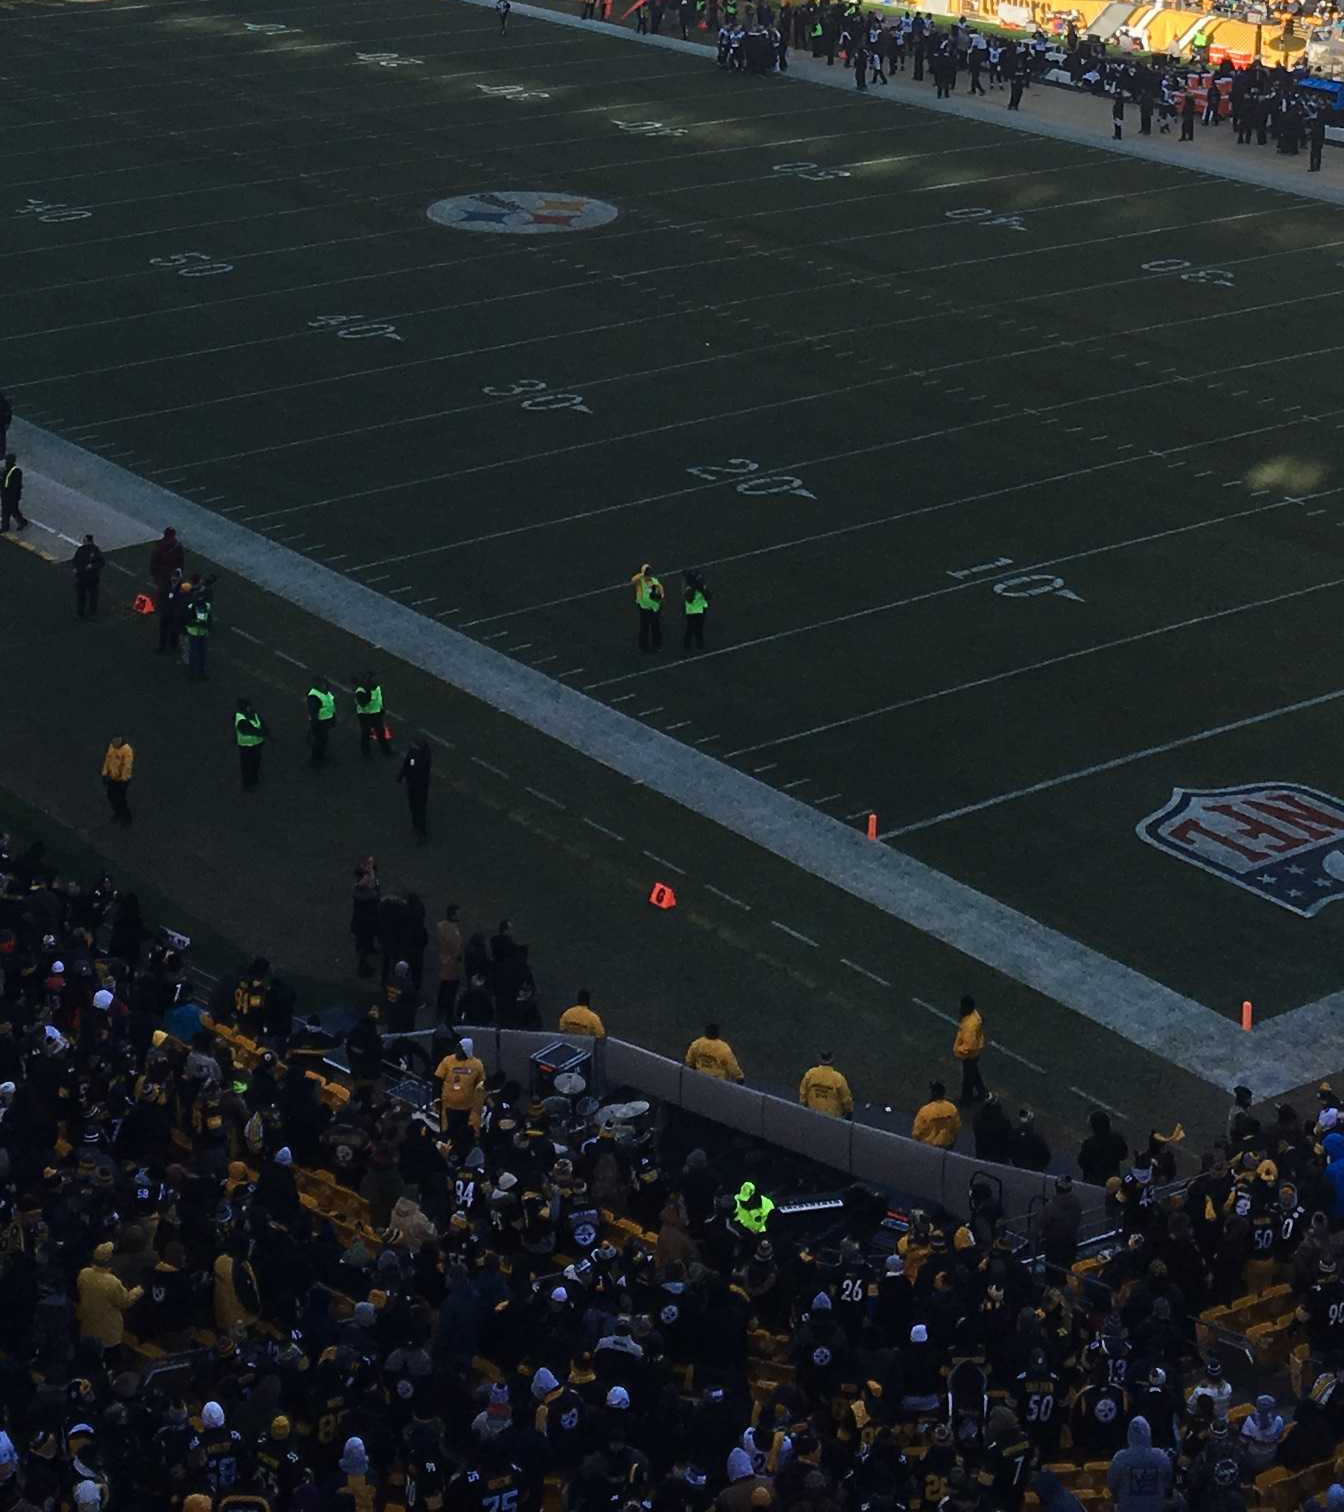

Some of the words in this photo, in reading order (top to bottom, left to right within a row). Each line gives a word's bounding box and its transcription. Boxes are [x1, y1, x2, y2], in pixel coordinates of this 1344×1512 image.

[148, 251, 235, 277] 50
[307, 313, 397, 339] 40
[482, 379, 584, 411] 30
[685, 457, 803, 496] 20
[945, 556, 1066, 598] 10
[454, 1180, 475, 1208] 94
[1253, 1228, 1274, 1250] 50
[840, 1278, 863, 1302] 26
[1026, 1393, 1053, 1423] 50
[482, 1488, 520, 1512] 75
